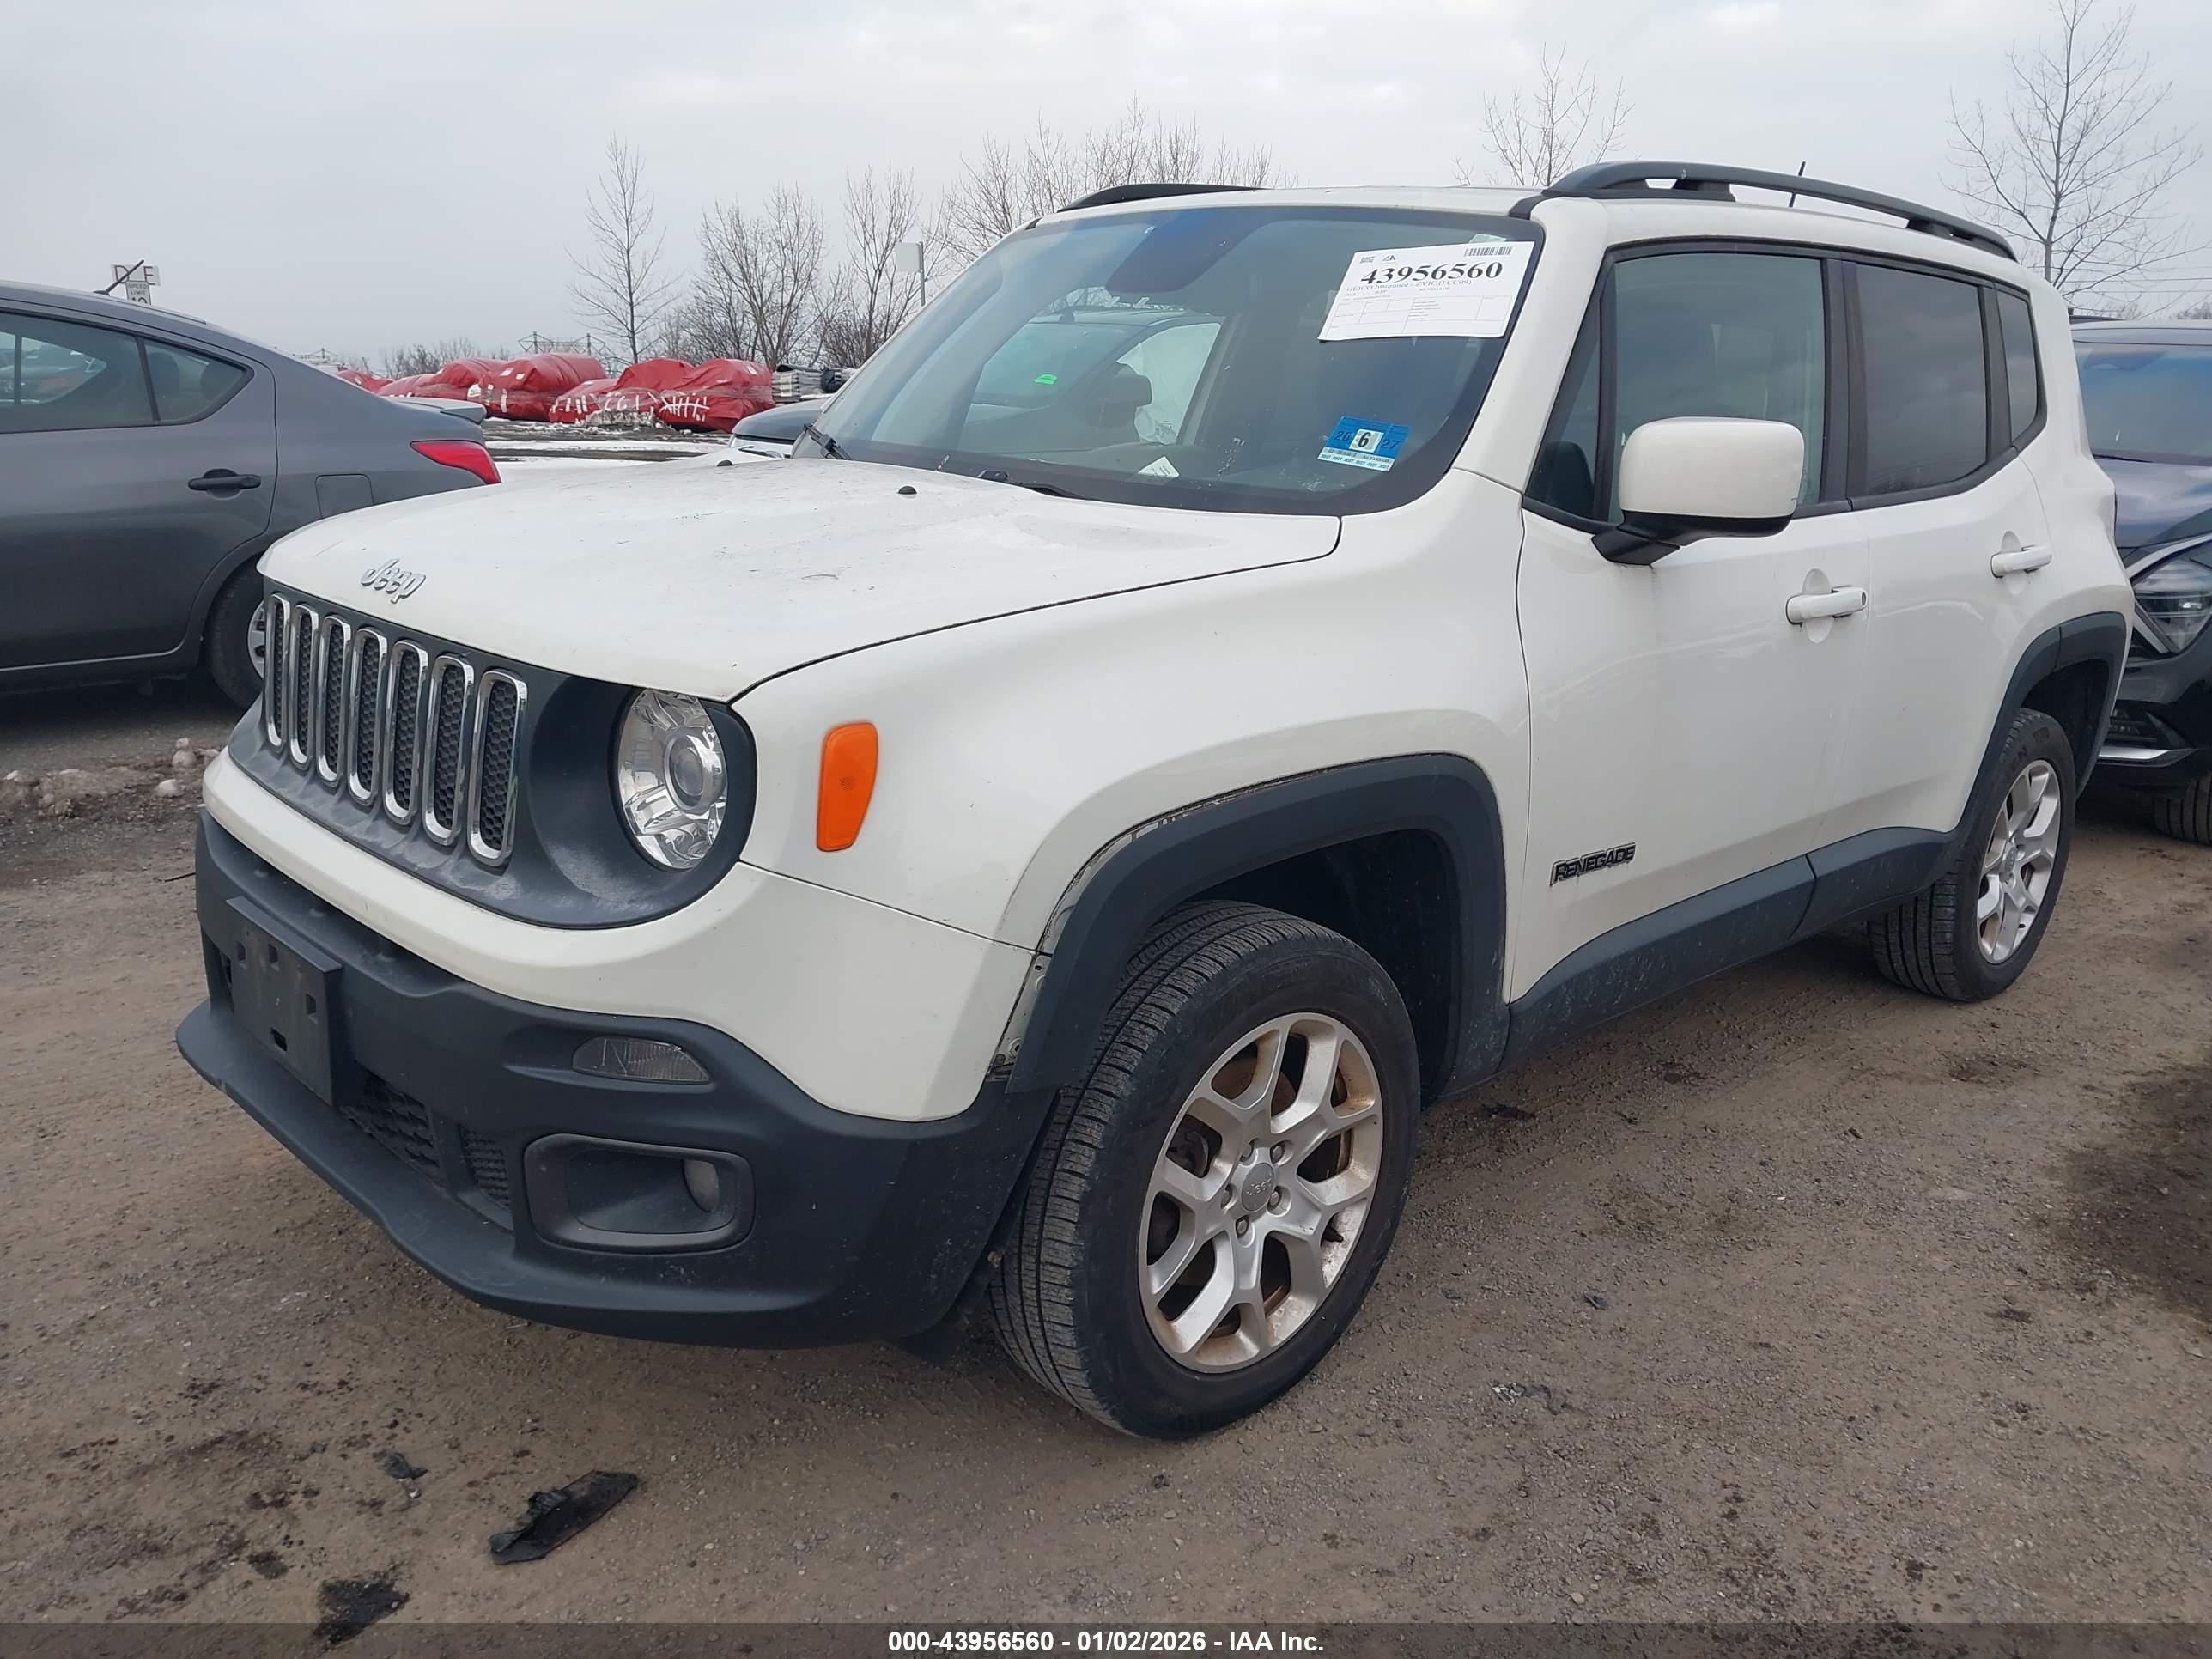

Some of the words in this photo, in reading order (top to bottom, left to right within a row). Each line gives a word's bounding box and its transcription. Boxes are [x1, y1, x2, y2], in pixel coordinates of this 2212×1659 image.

[143, 265, 155, 285] E
[1360, 261, 1503, 284] 43956560
[1358, 432, 1371, 447] 6
[361, 558, 426, 604] Jeep
[1549, 842, 1636, 886] RENEGADE
